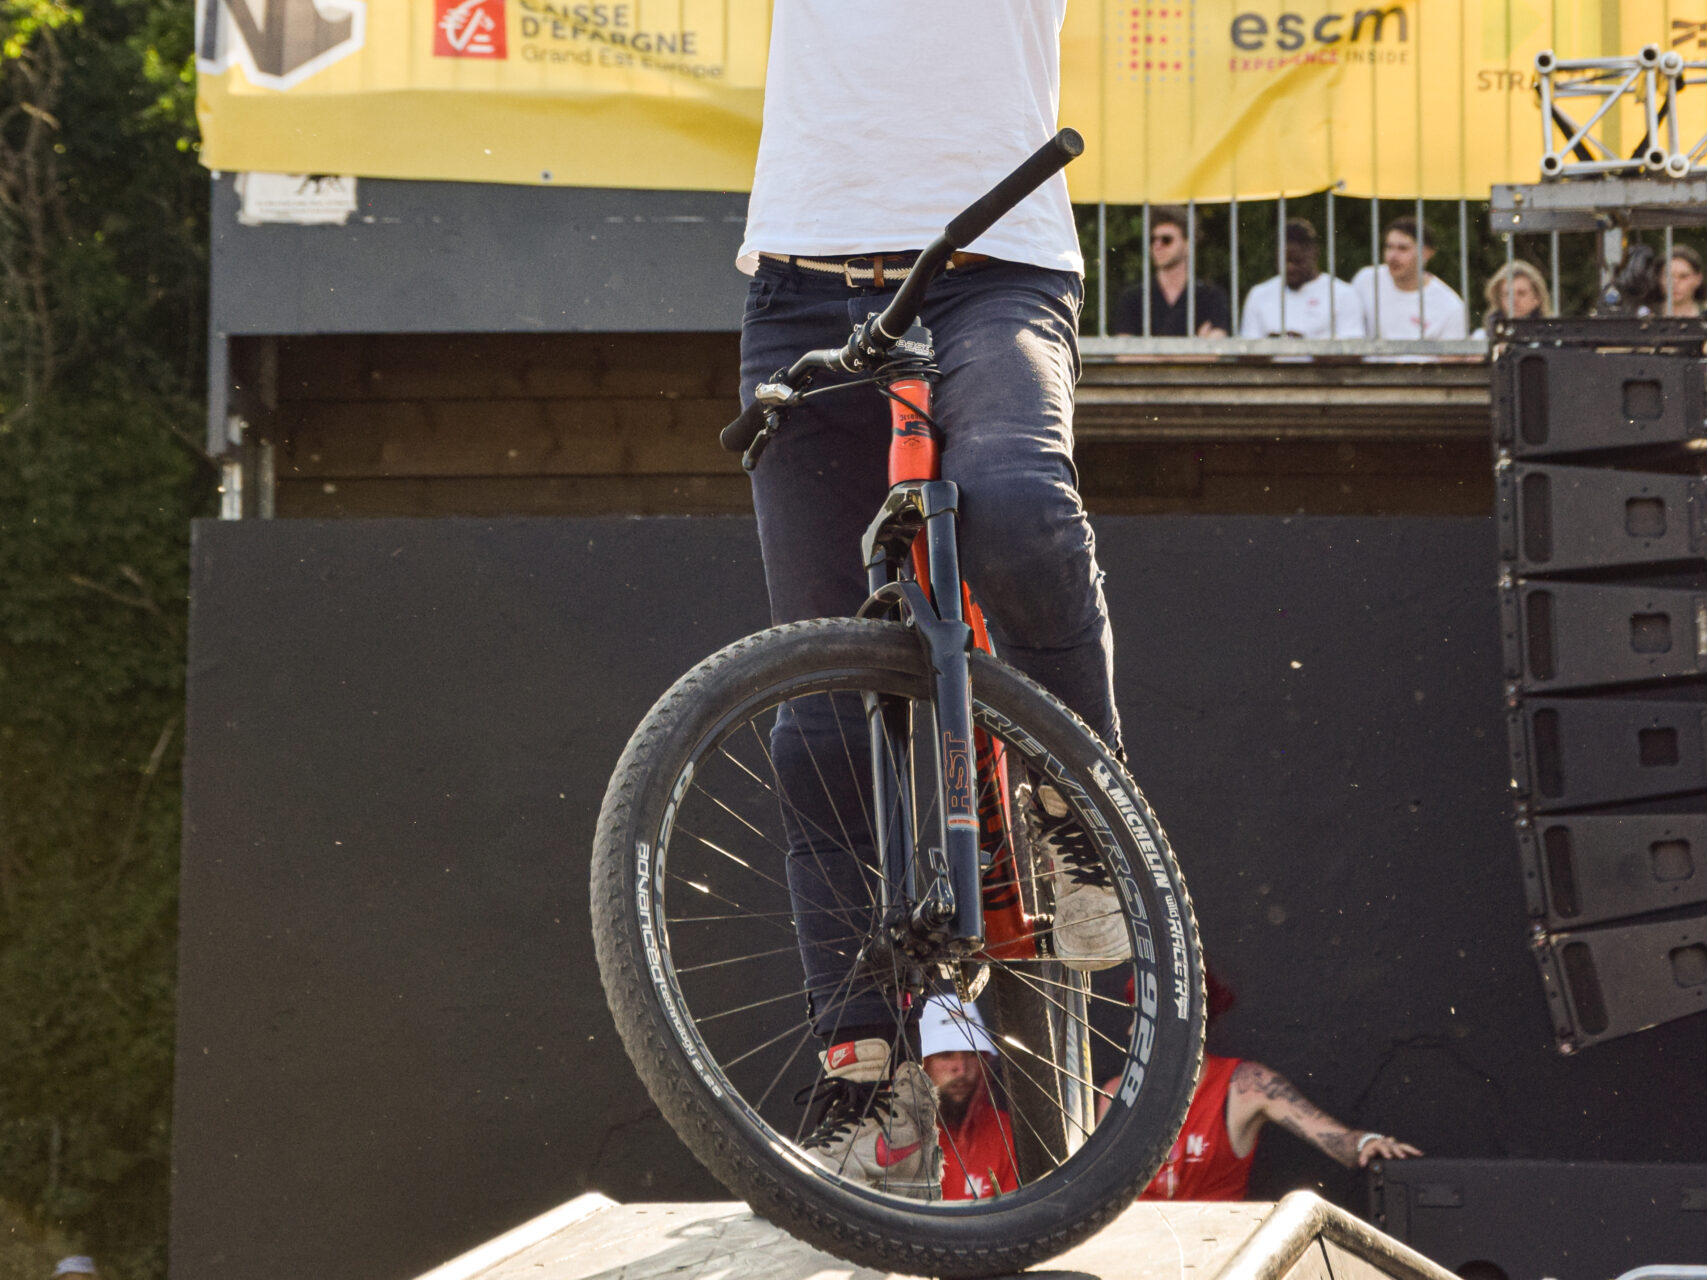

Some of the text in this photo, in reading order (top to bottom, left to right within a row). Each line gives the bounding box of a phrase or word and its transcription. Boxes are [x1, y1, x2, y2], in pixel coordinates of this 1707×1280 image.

[1231, 7, 1408, 51] escm
[943, 731, 972, 816] RST
[1108, 787, 1172, 888] MICHELIN
